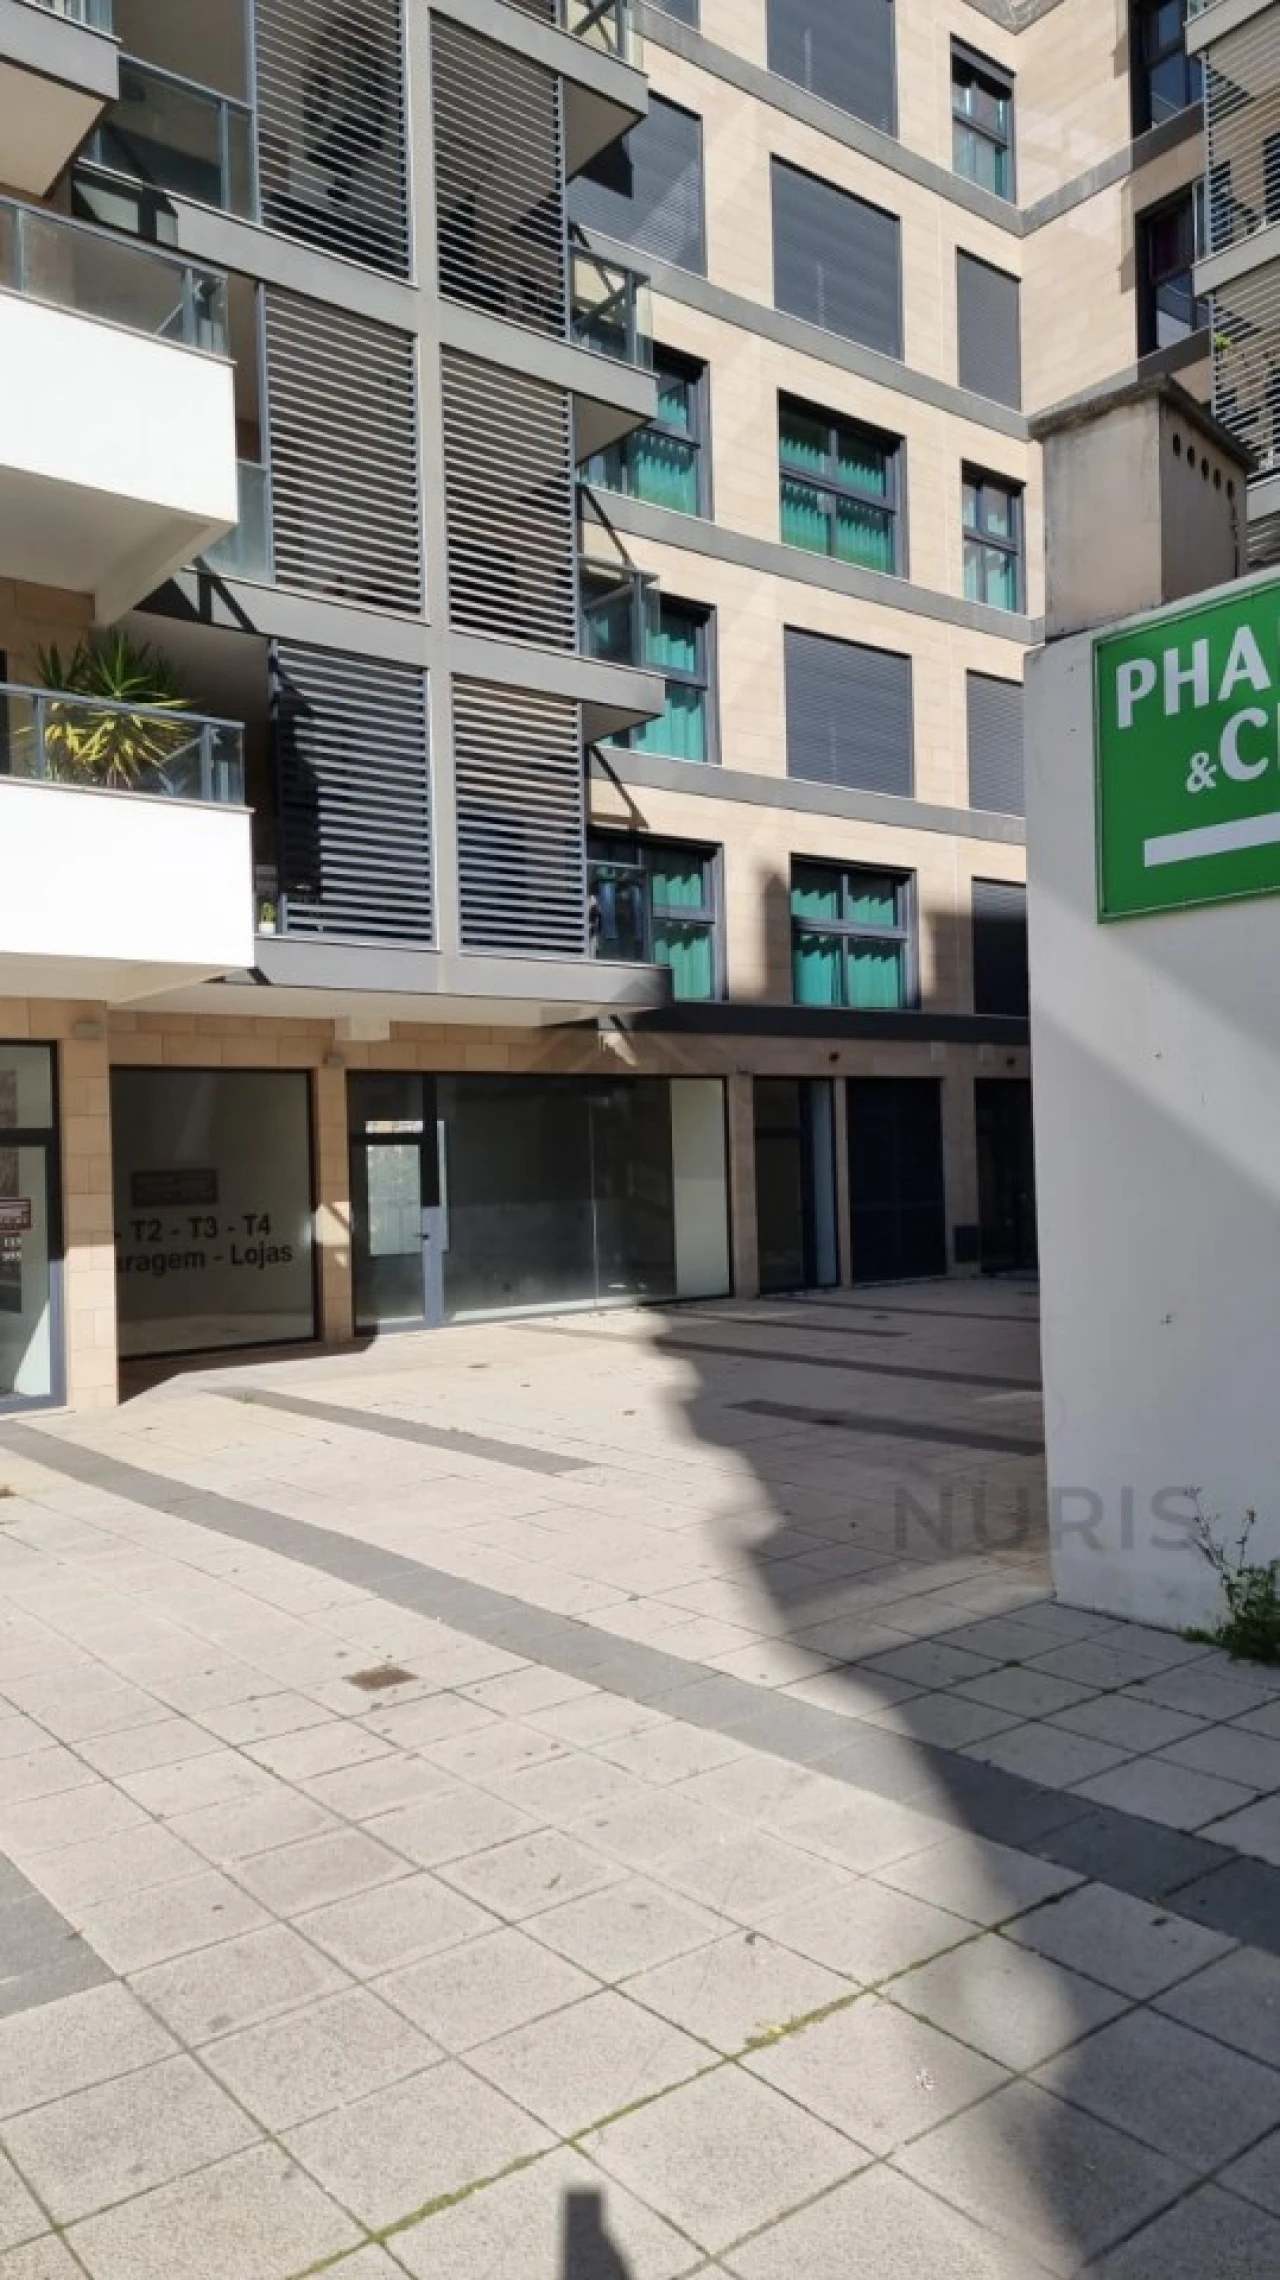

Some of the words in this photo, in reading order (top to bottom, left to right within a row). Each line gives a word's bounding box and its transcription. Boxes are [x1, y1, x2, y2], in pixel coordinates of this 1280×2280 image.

[1116, 617, 1280, 730] PHA
[1186, 702, 1280, 793] &C
[129, 1218, 162, 1243] T2
[187, 1215, 219, 1240] T3
[242, 1211, 271, 1237] T4
[230, 1241, 293, 1270] Lojas
